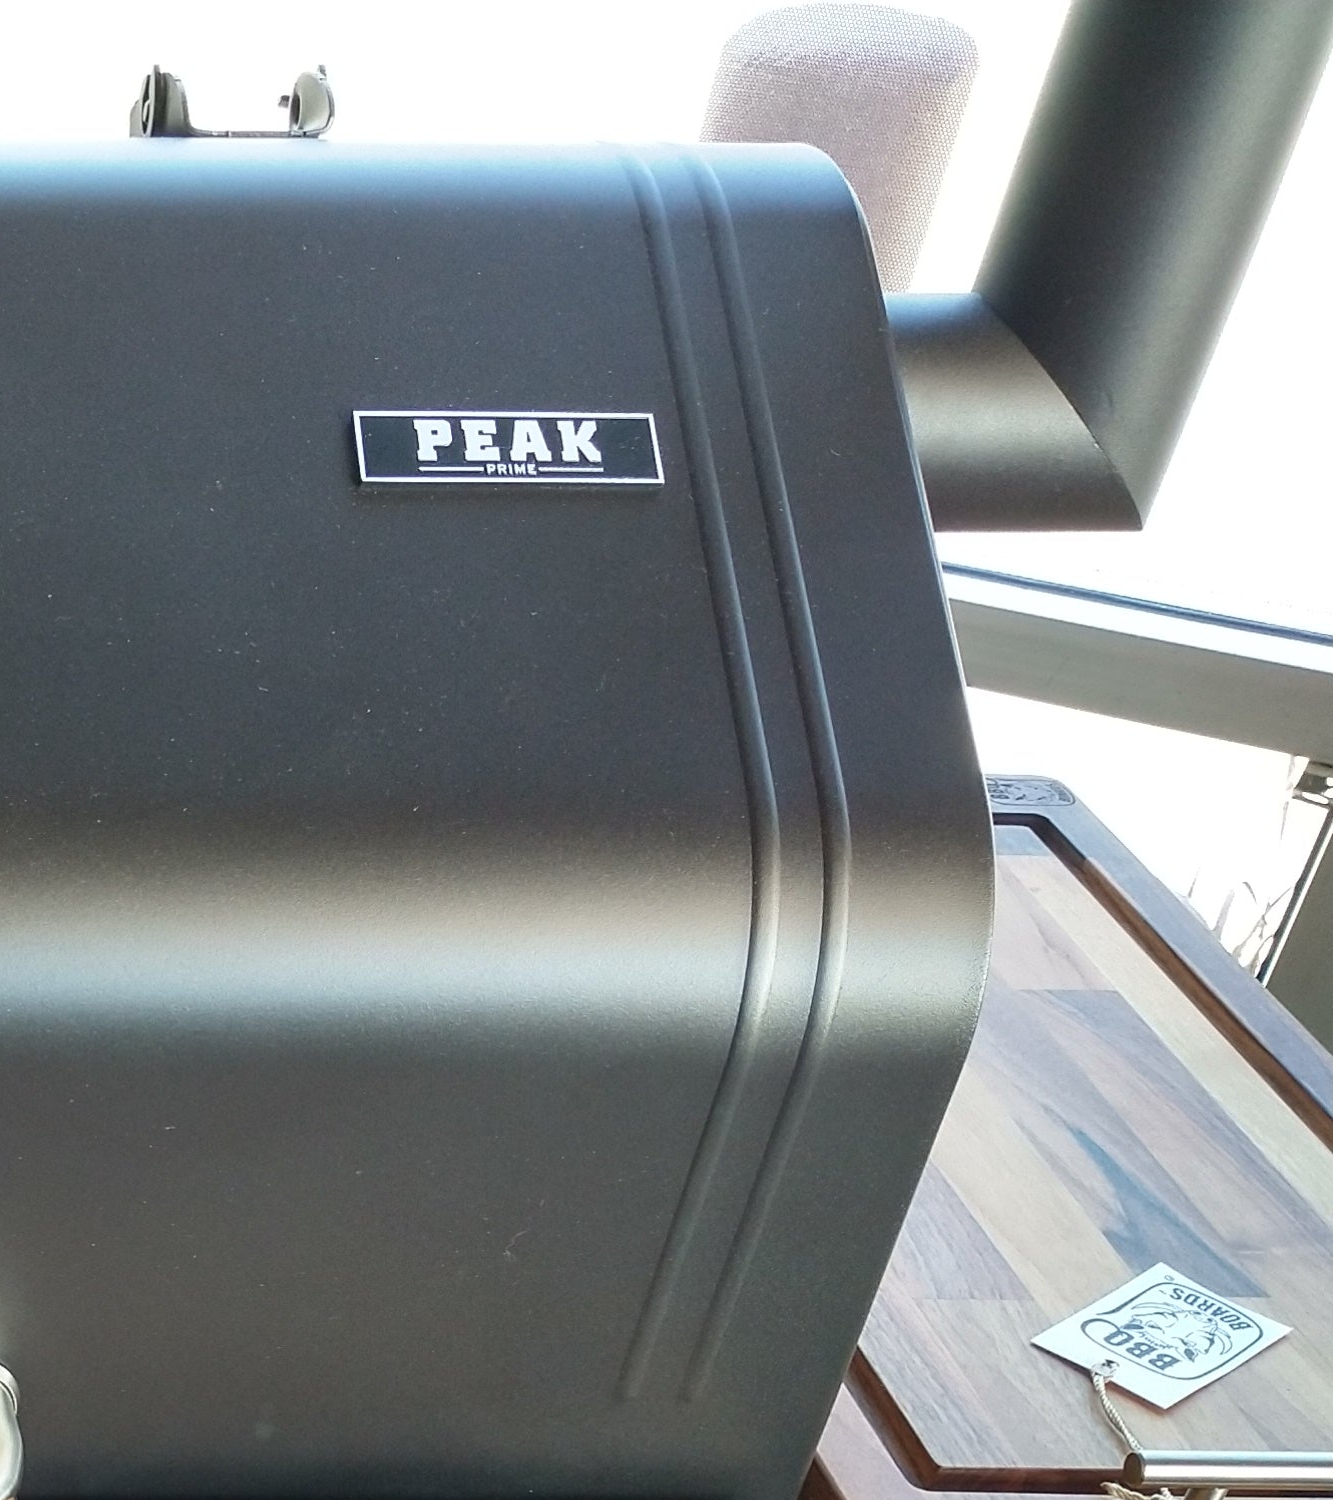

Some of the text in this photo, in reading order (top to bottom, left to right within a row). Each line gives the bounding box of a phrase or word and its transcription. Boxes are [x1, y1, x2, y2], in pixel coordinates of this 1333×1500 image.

[413, 419, 601, 463] PEAK
[486, 463, 538, 476] PRIME
[1169, 1287, 1254, 1331] BOARDS
[1103, 1330, 1182, 1371] BBQ
